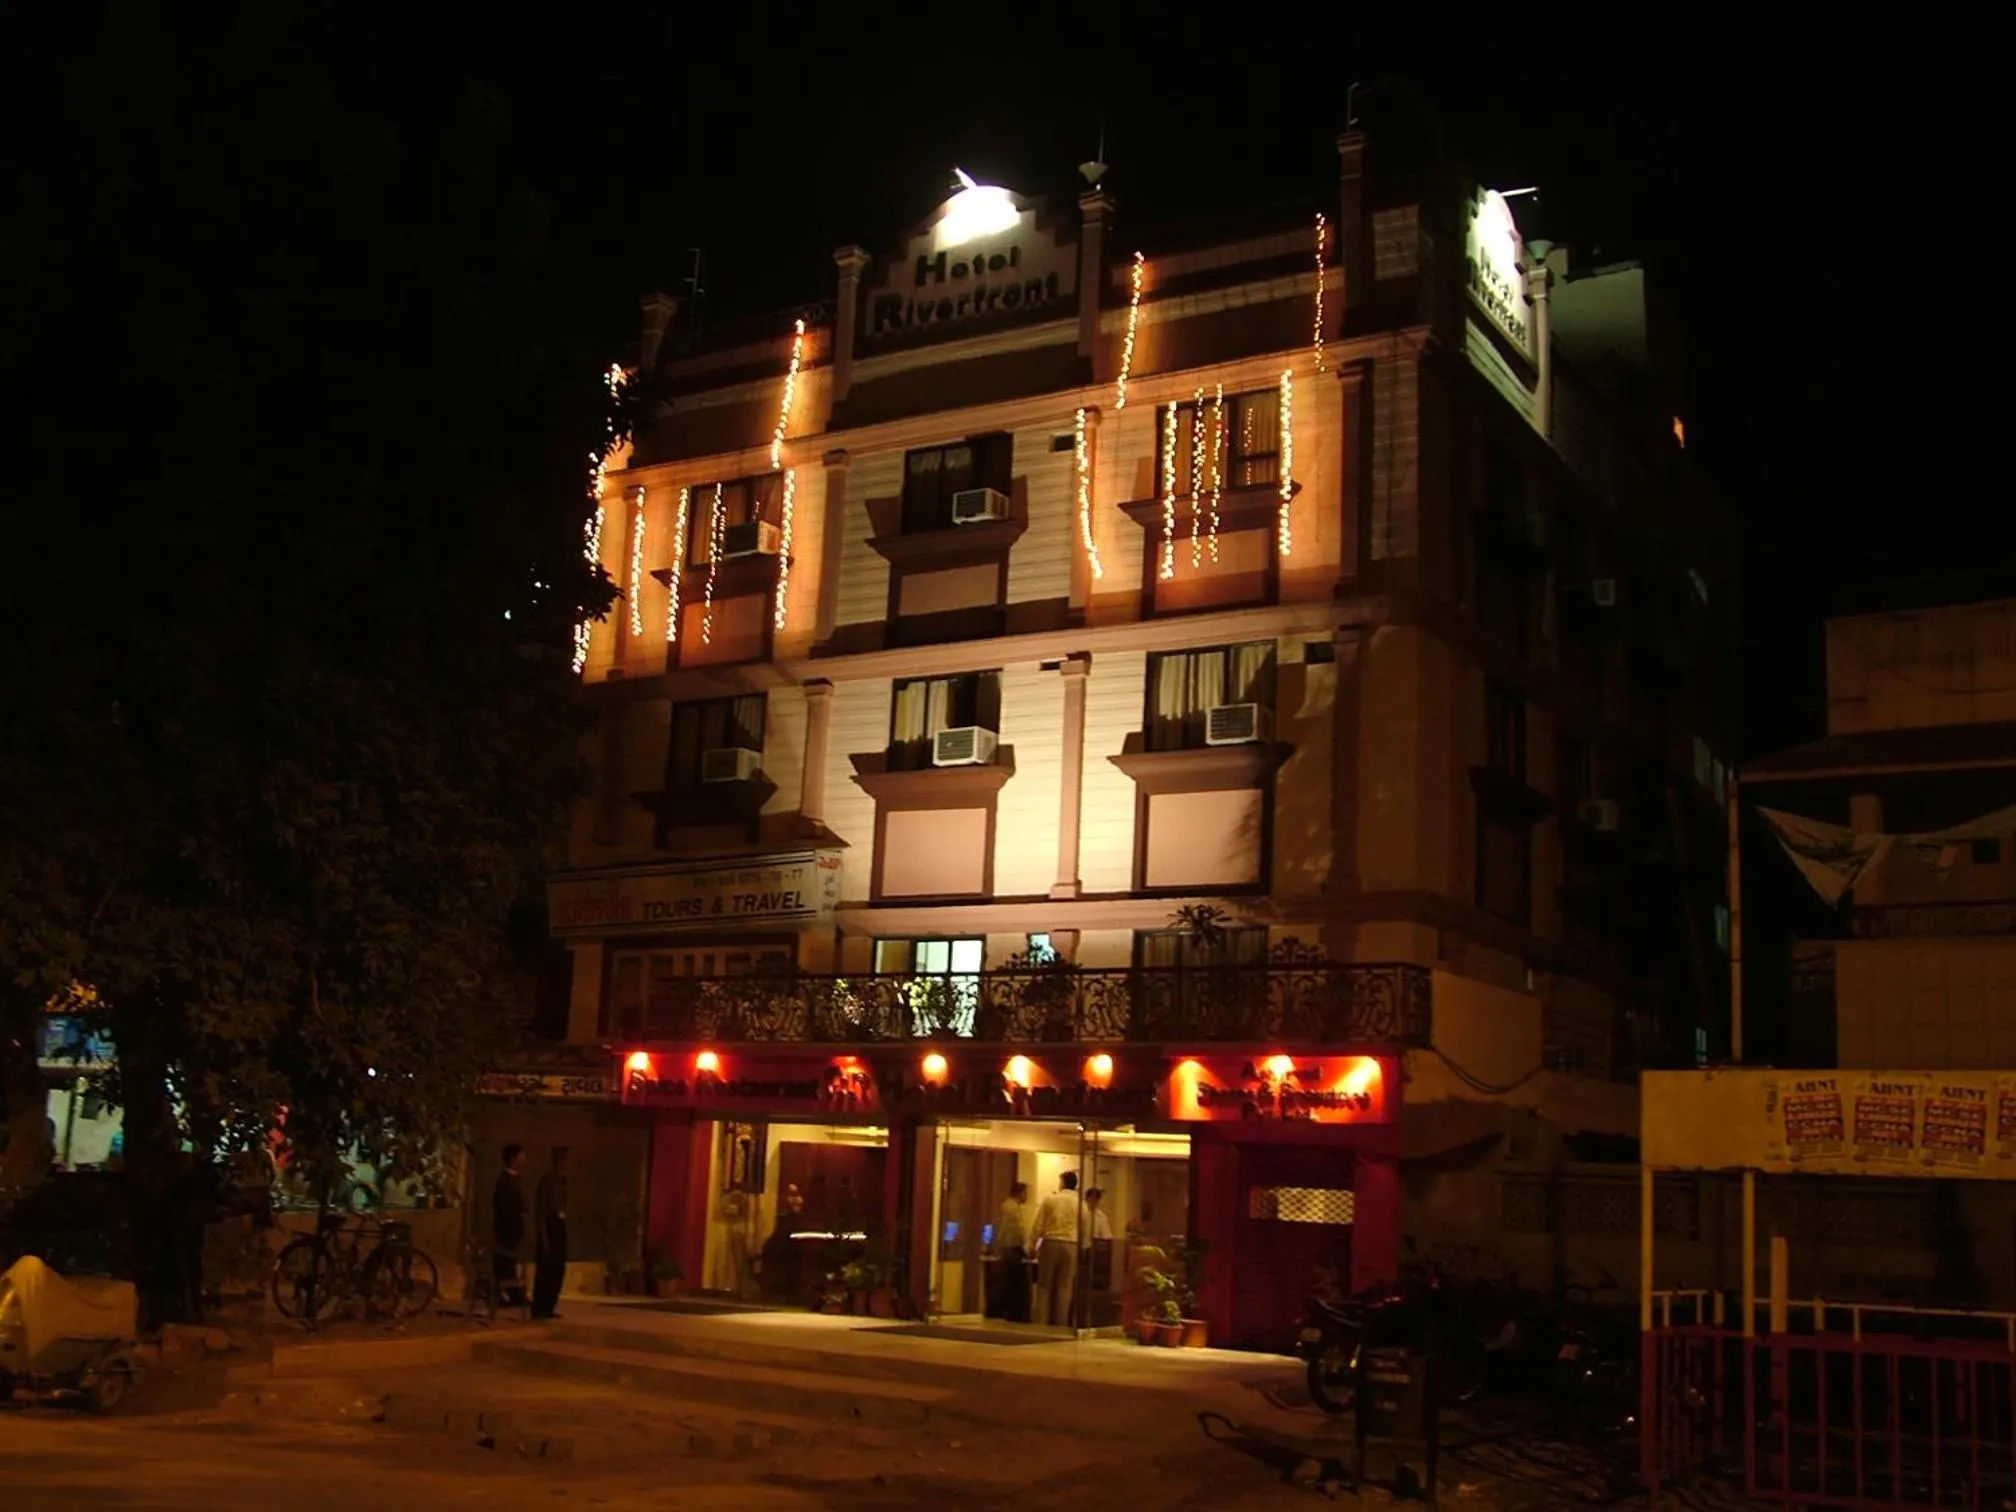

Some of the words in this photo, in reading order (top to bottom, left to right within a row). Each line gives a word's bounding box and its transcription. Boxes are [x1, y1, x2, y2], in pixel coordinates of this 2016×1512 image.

[914, 246, 1018, 287] Hotel
[874, 271, 1059, 331] Riverfront
[642, 898, 702, 919] TOURS
[710, 898, 723, 914] &
[731, 891, 805, 913] TRAVEL
